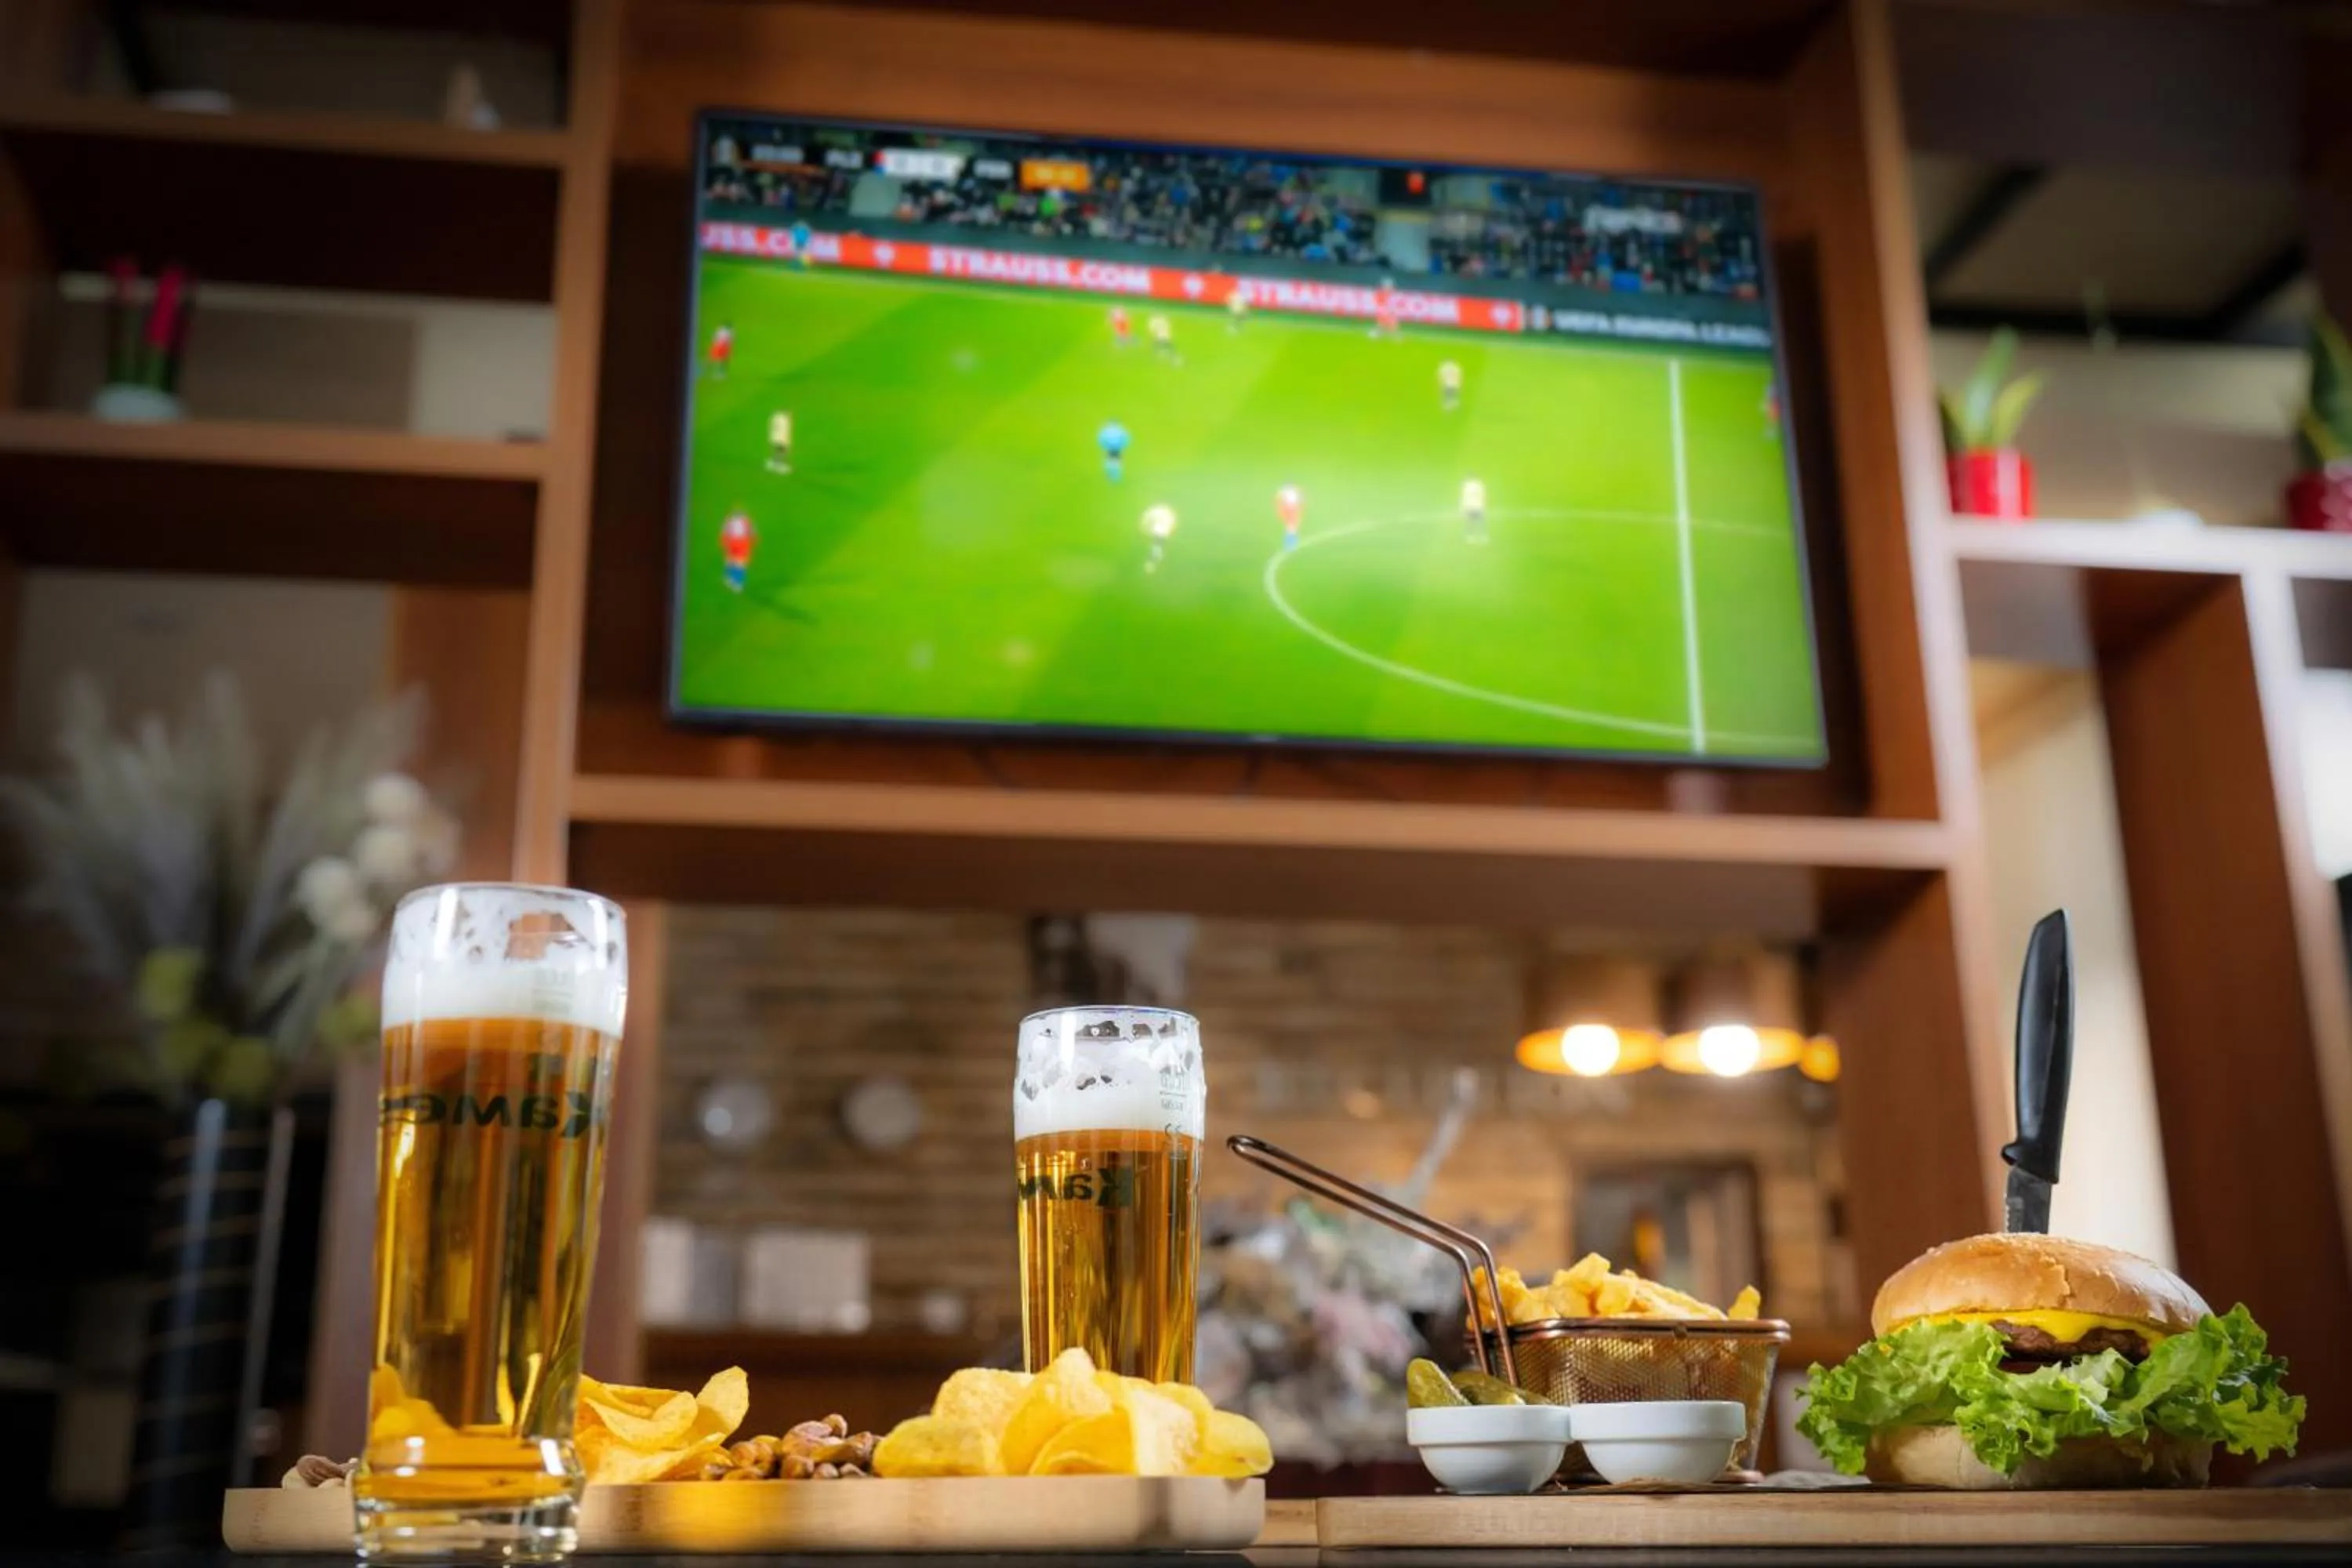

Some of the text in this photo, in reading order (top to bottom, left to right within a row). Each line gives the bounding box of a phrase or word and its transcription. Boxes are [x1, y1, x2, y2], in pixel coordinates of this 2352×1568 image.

[929, 245, 1151, 293] STRAUSS.COM
[1555, 310, 1610, 332] UEFA
[1614, 314, 1697, 343] EUROPA
